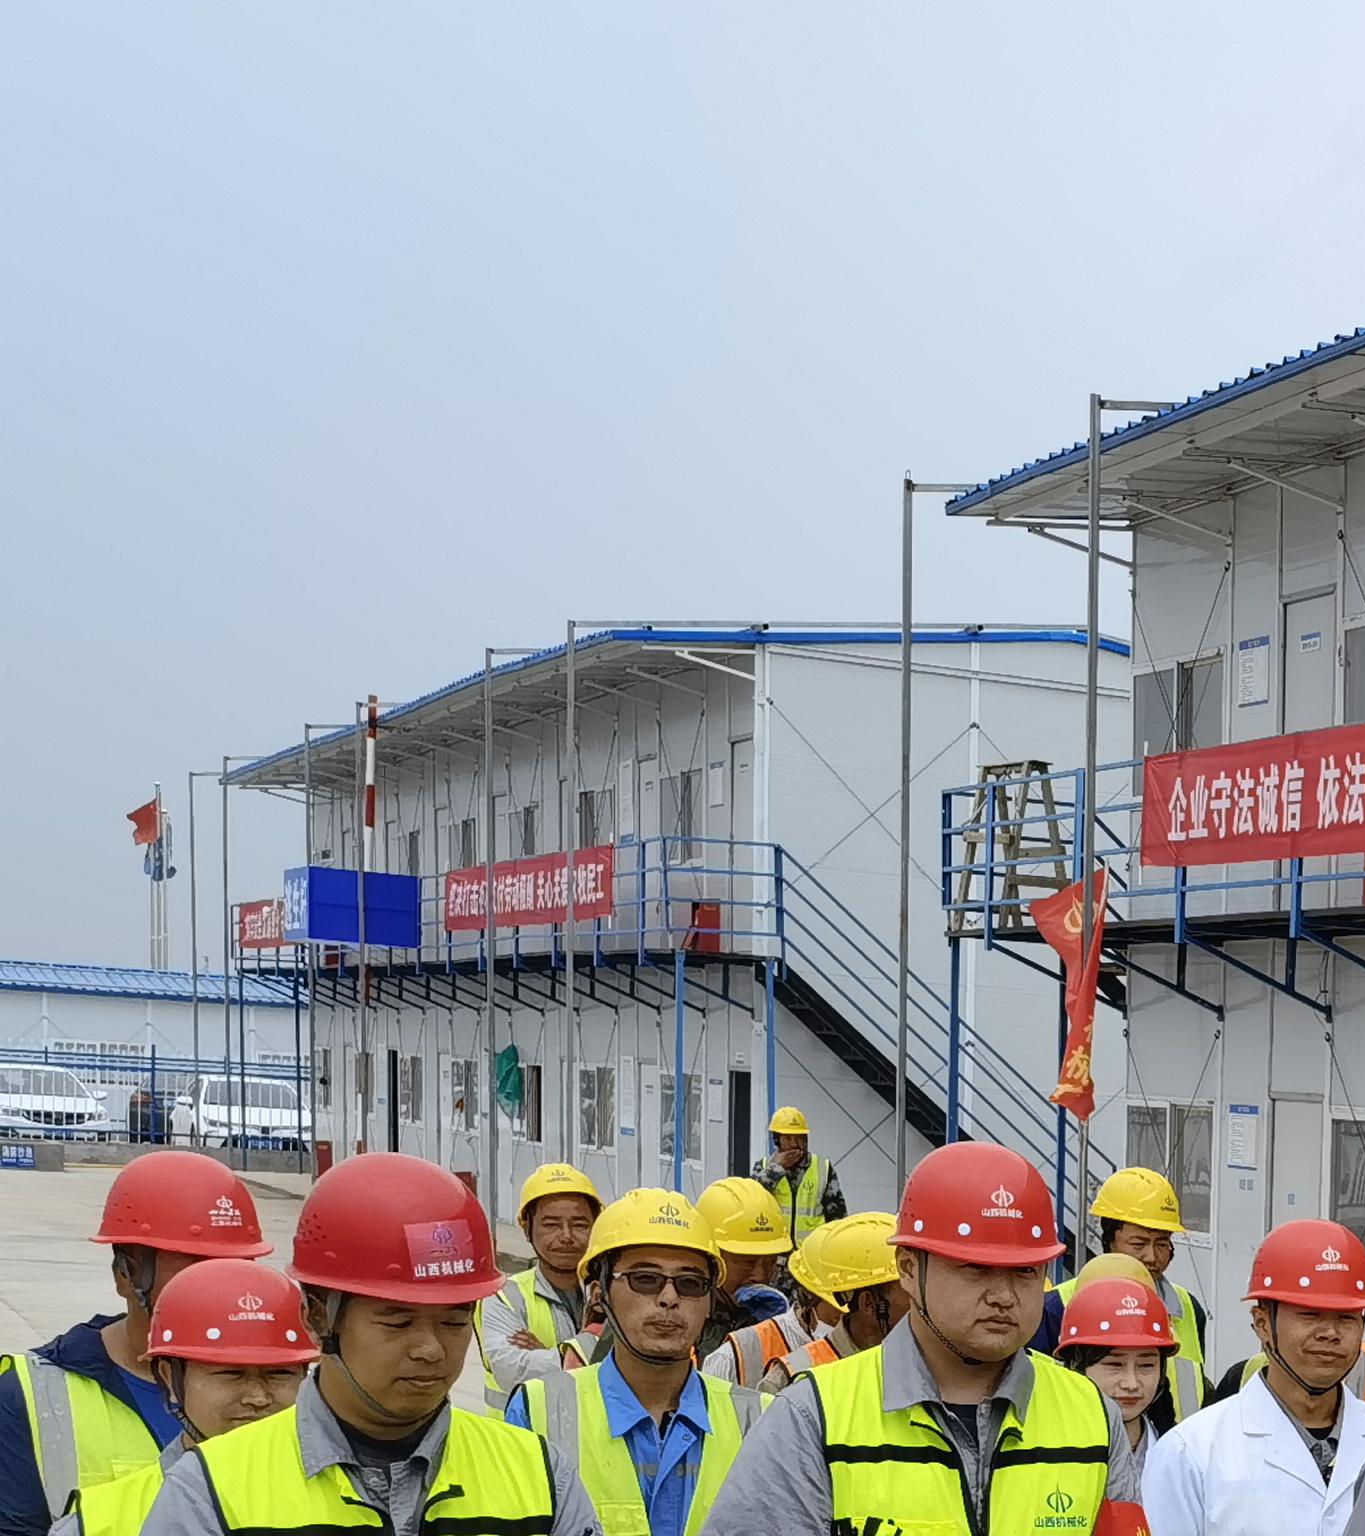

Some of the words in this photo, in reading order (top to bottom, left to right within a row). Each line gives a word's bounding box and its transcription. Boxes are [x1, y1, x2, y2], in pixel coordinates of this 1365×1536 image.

[1167, 759, 1305, 842] 企业守法诚信
[414, 1258, 476, 1279] 山西机械化
